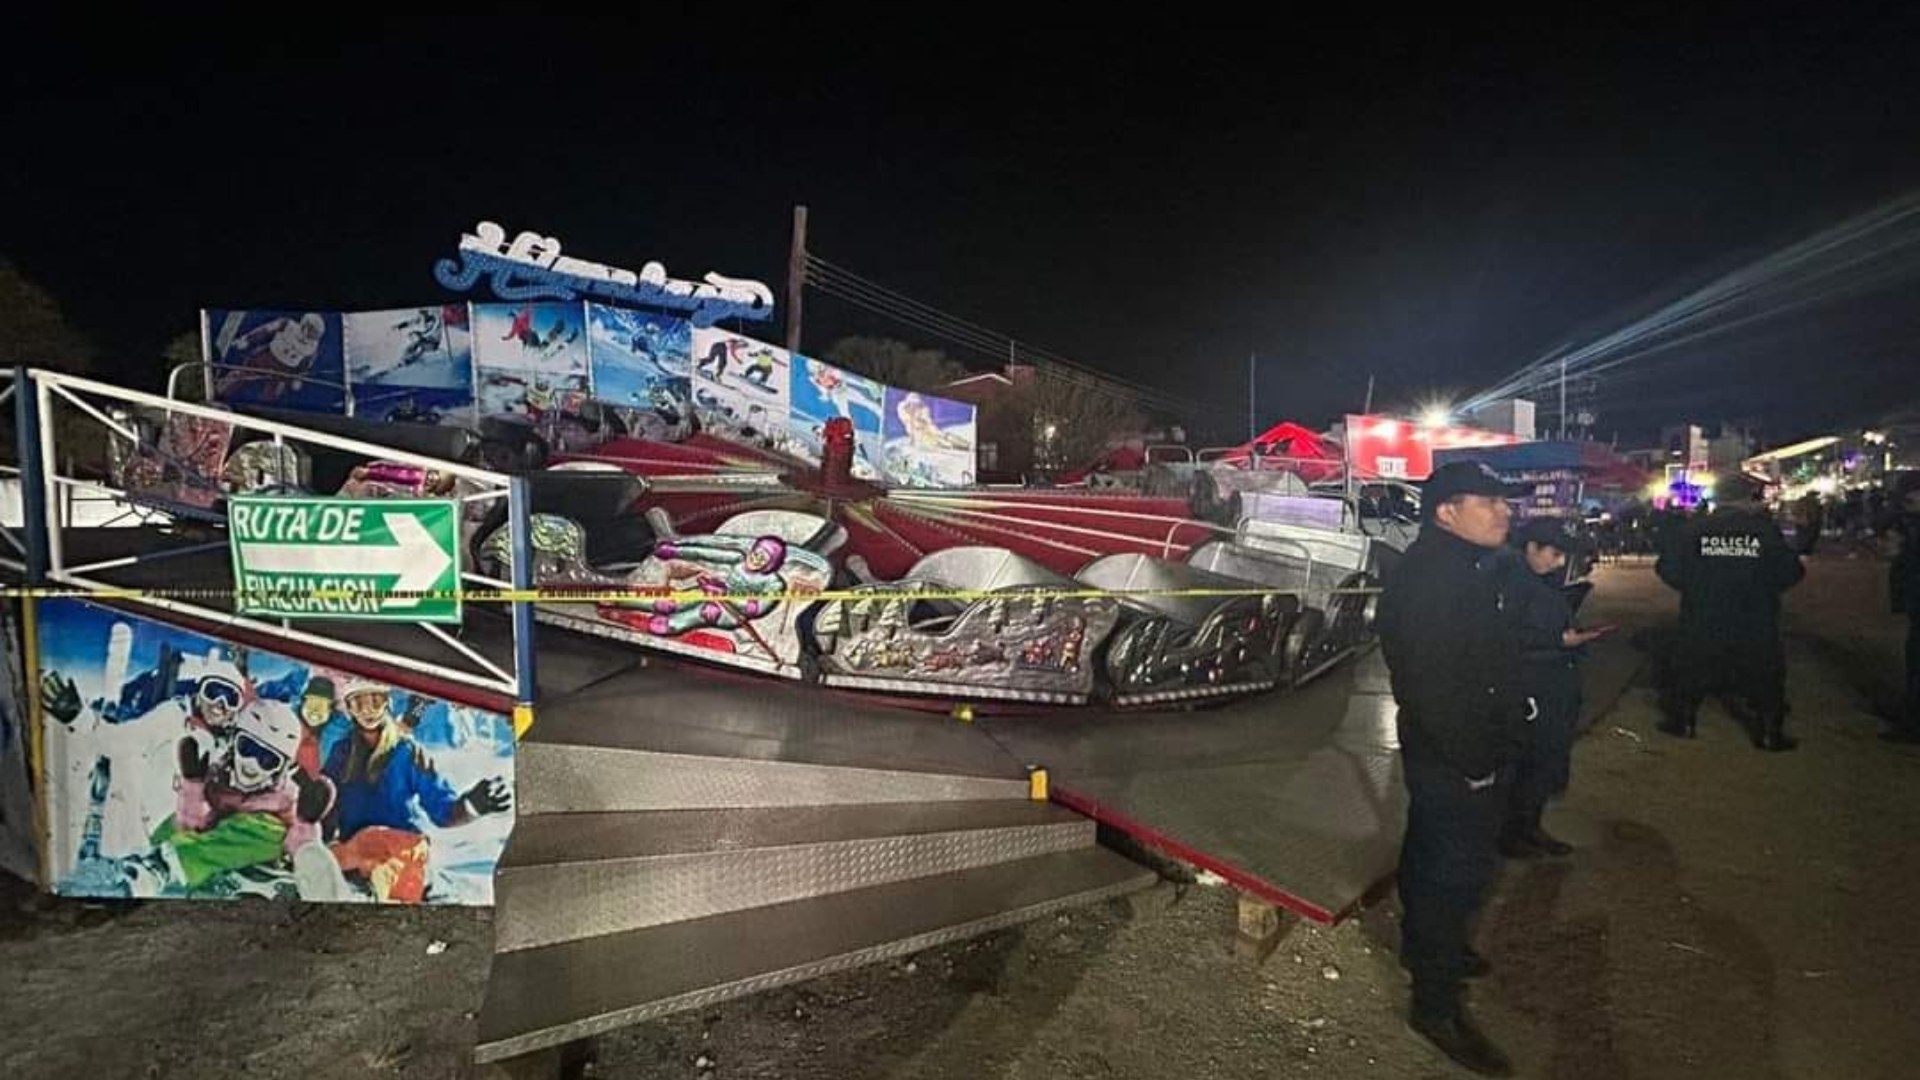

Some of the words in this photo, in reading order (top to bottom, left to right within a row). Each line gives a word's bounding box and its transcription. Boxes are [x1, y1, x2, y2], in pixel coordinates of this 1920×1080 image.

[233, 504, 309, 540] RUTA
[316, 507, 366, 541] DE
[1701, 535, 1760, 548] POLICÍA
[1701, 546, 1759, 557] MUNICIPAL
